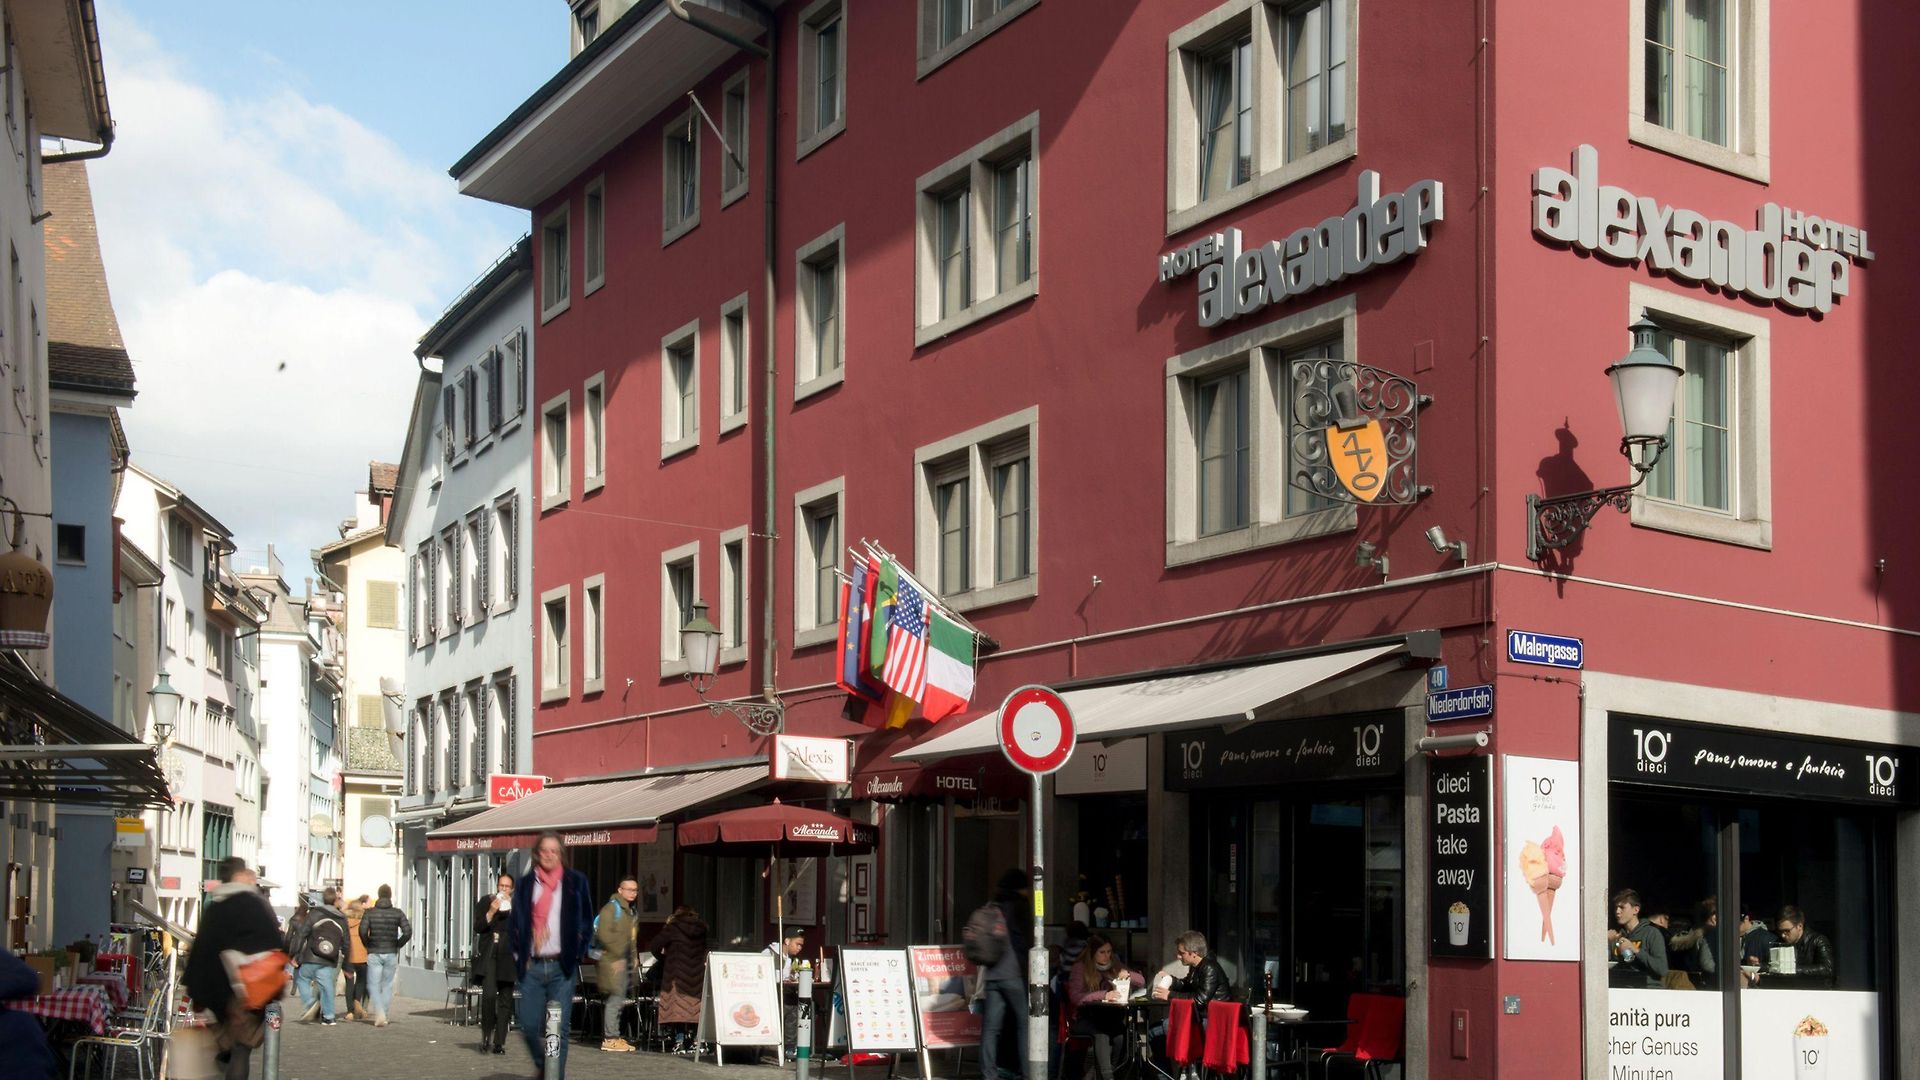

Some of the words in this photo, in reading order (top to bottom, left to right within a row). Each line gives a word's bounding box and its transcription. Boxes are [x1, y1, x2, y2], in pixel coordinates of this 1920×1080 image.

[1531, 144, 1850, 315] alexander
[1782, 207, 1875, 260] HOTEL
[1159, 232, 1224, 283] HOTEL
[1199, 169, 1444, 328] alexander
[1514, 634, 1578, 663] Malergasse
[1431, 670, 1443, 687] 40
[1429, 689, 1490, 715] Niederdorfstr.
[1295, 738, 1335, 763] fantasia
[1356, 753, 1381, 767] dieci
[1183, 768, 1203, 780] dieci
[1637, 760, 1667, 774] dieci
[1785, 762, 1793, 770] e
[1797, 756, 1846, 780] fantasia
[866, 776, 903, 794] Alexander
[936, 776, 977, 791] HOTEL
[1437, 772, 1470, 793] dieci
[1869, 783, 1896, 797] dieci
[1437, 803, 1480, 824] Pasta
[793, 824, 839, 837] Alexander
[1437, 834, 1468, 854] take
[1437, 869, 1474, 890] away
[917, 950, 954, 961] Zimmer
[918, 962, 966, 973] Vacancies
[1655, 1013, 1690, 1031] pura
[1642, 1036, 1698, 1056] Genuss
[1613, 1065, 1673, 1080] Minuten
